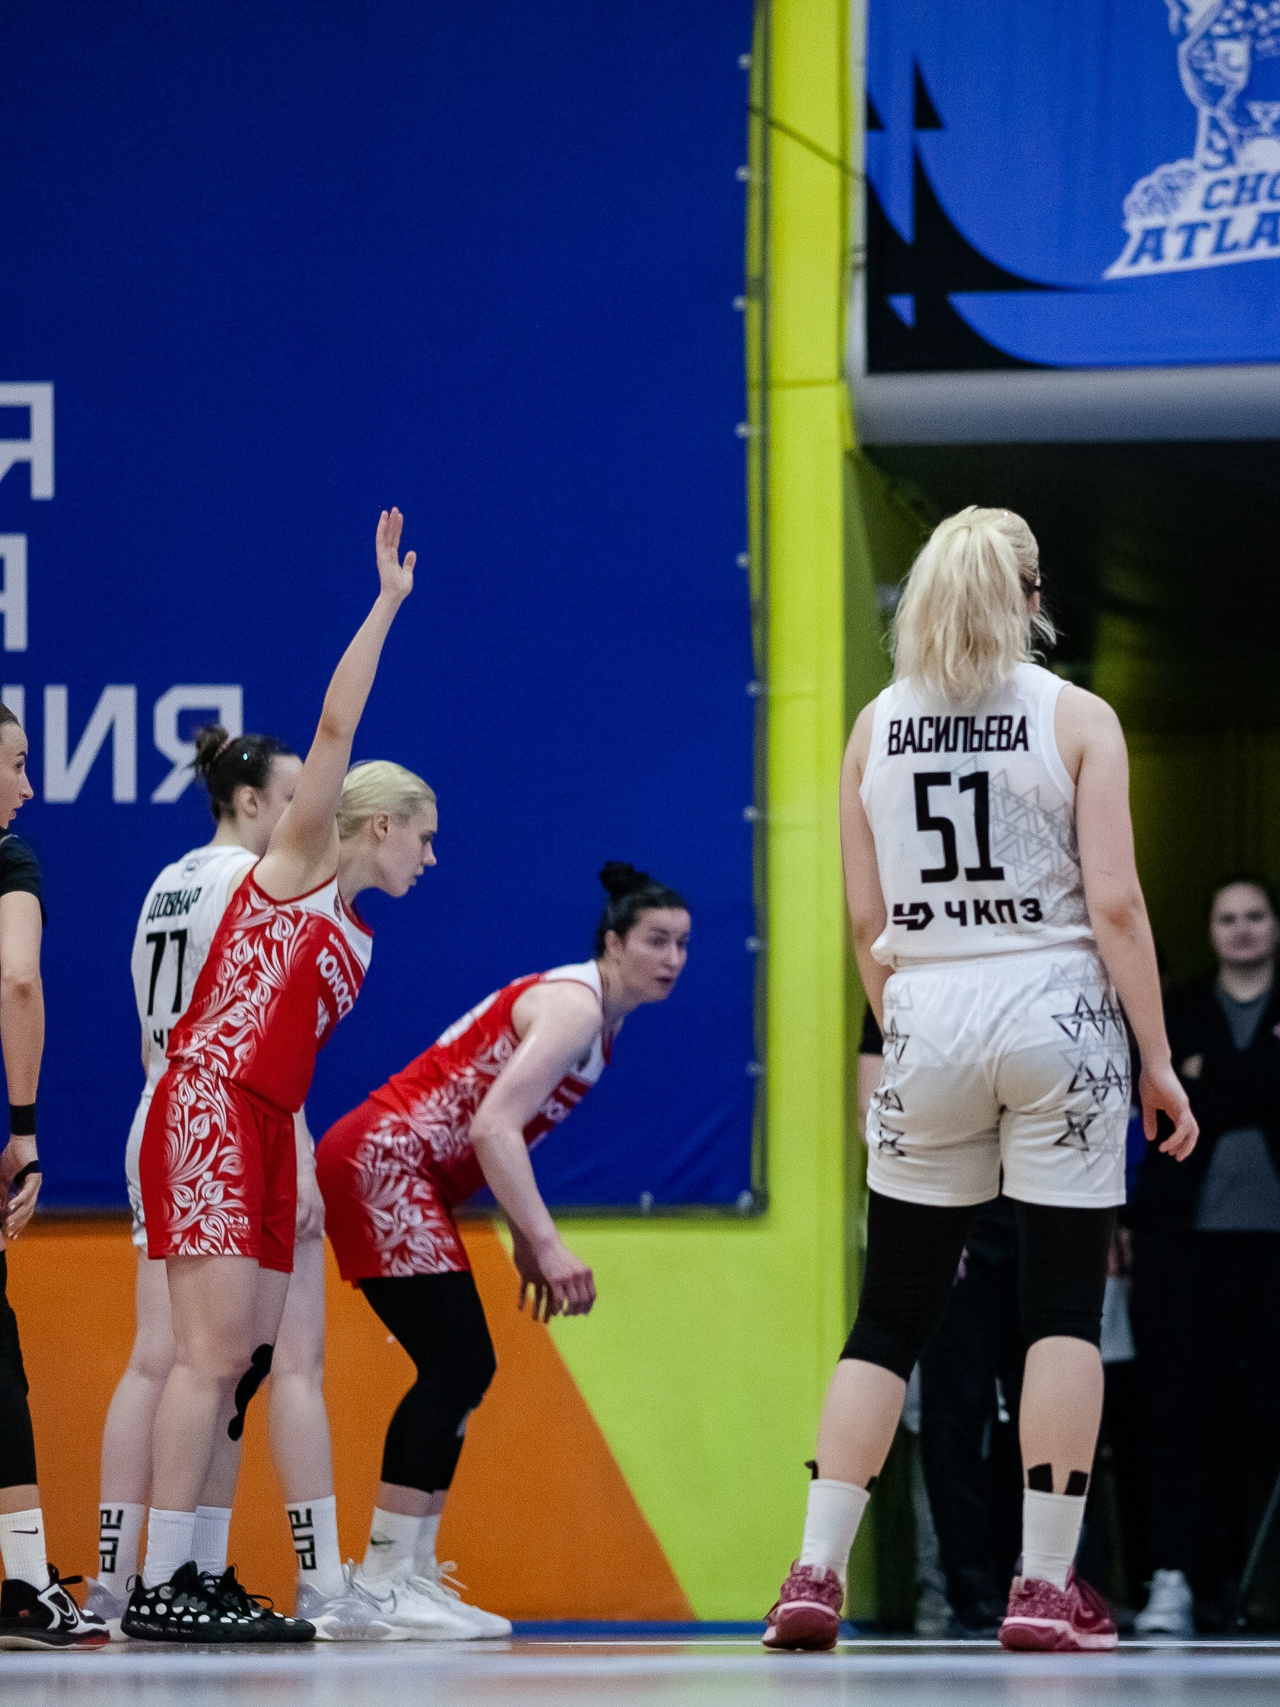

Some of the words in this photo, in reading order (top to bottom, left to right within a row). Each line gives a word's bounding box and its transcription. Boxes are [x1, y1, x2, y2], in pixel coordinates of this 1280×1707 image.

[0, 684, 243, 803] ИЯ
[887, 715, 1029, 756] ВАСИЛЬЕВА
[914, 770, 1005, 883] 51
[944, 898, 1043, 926] ЧКПЗ
